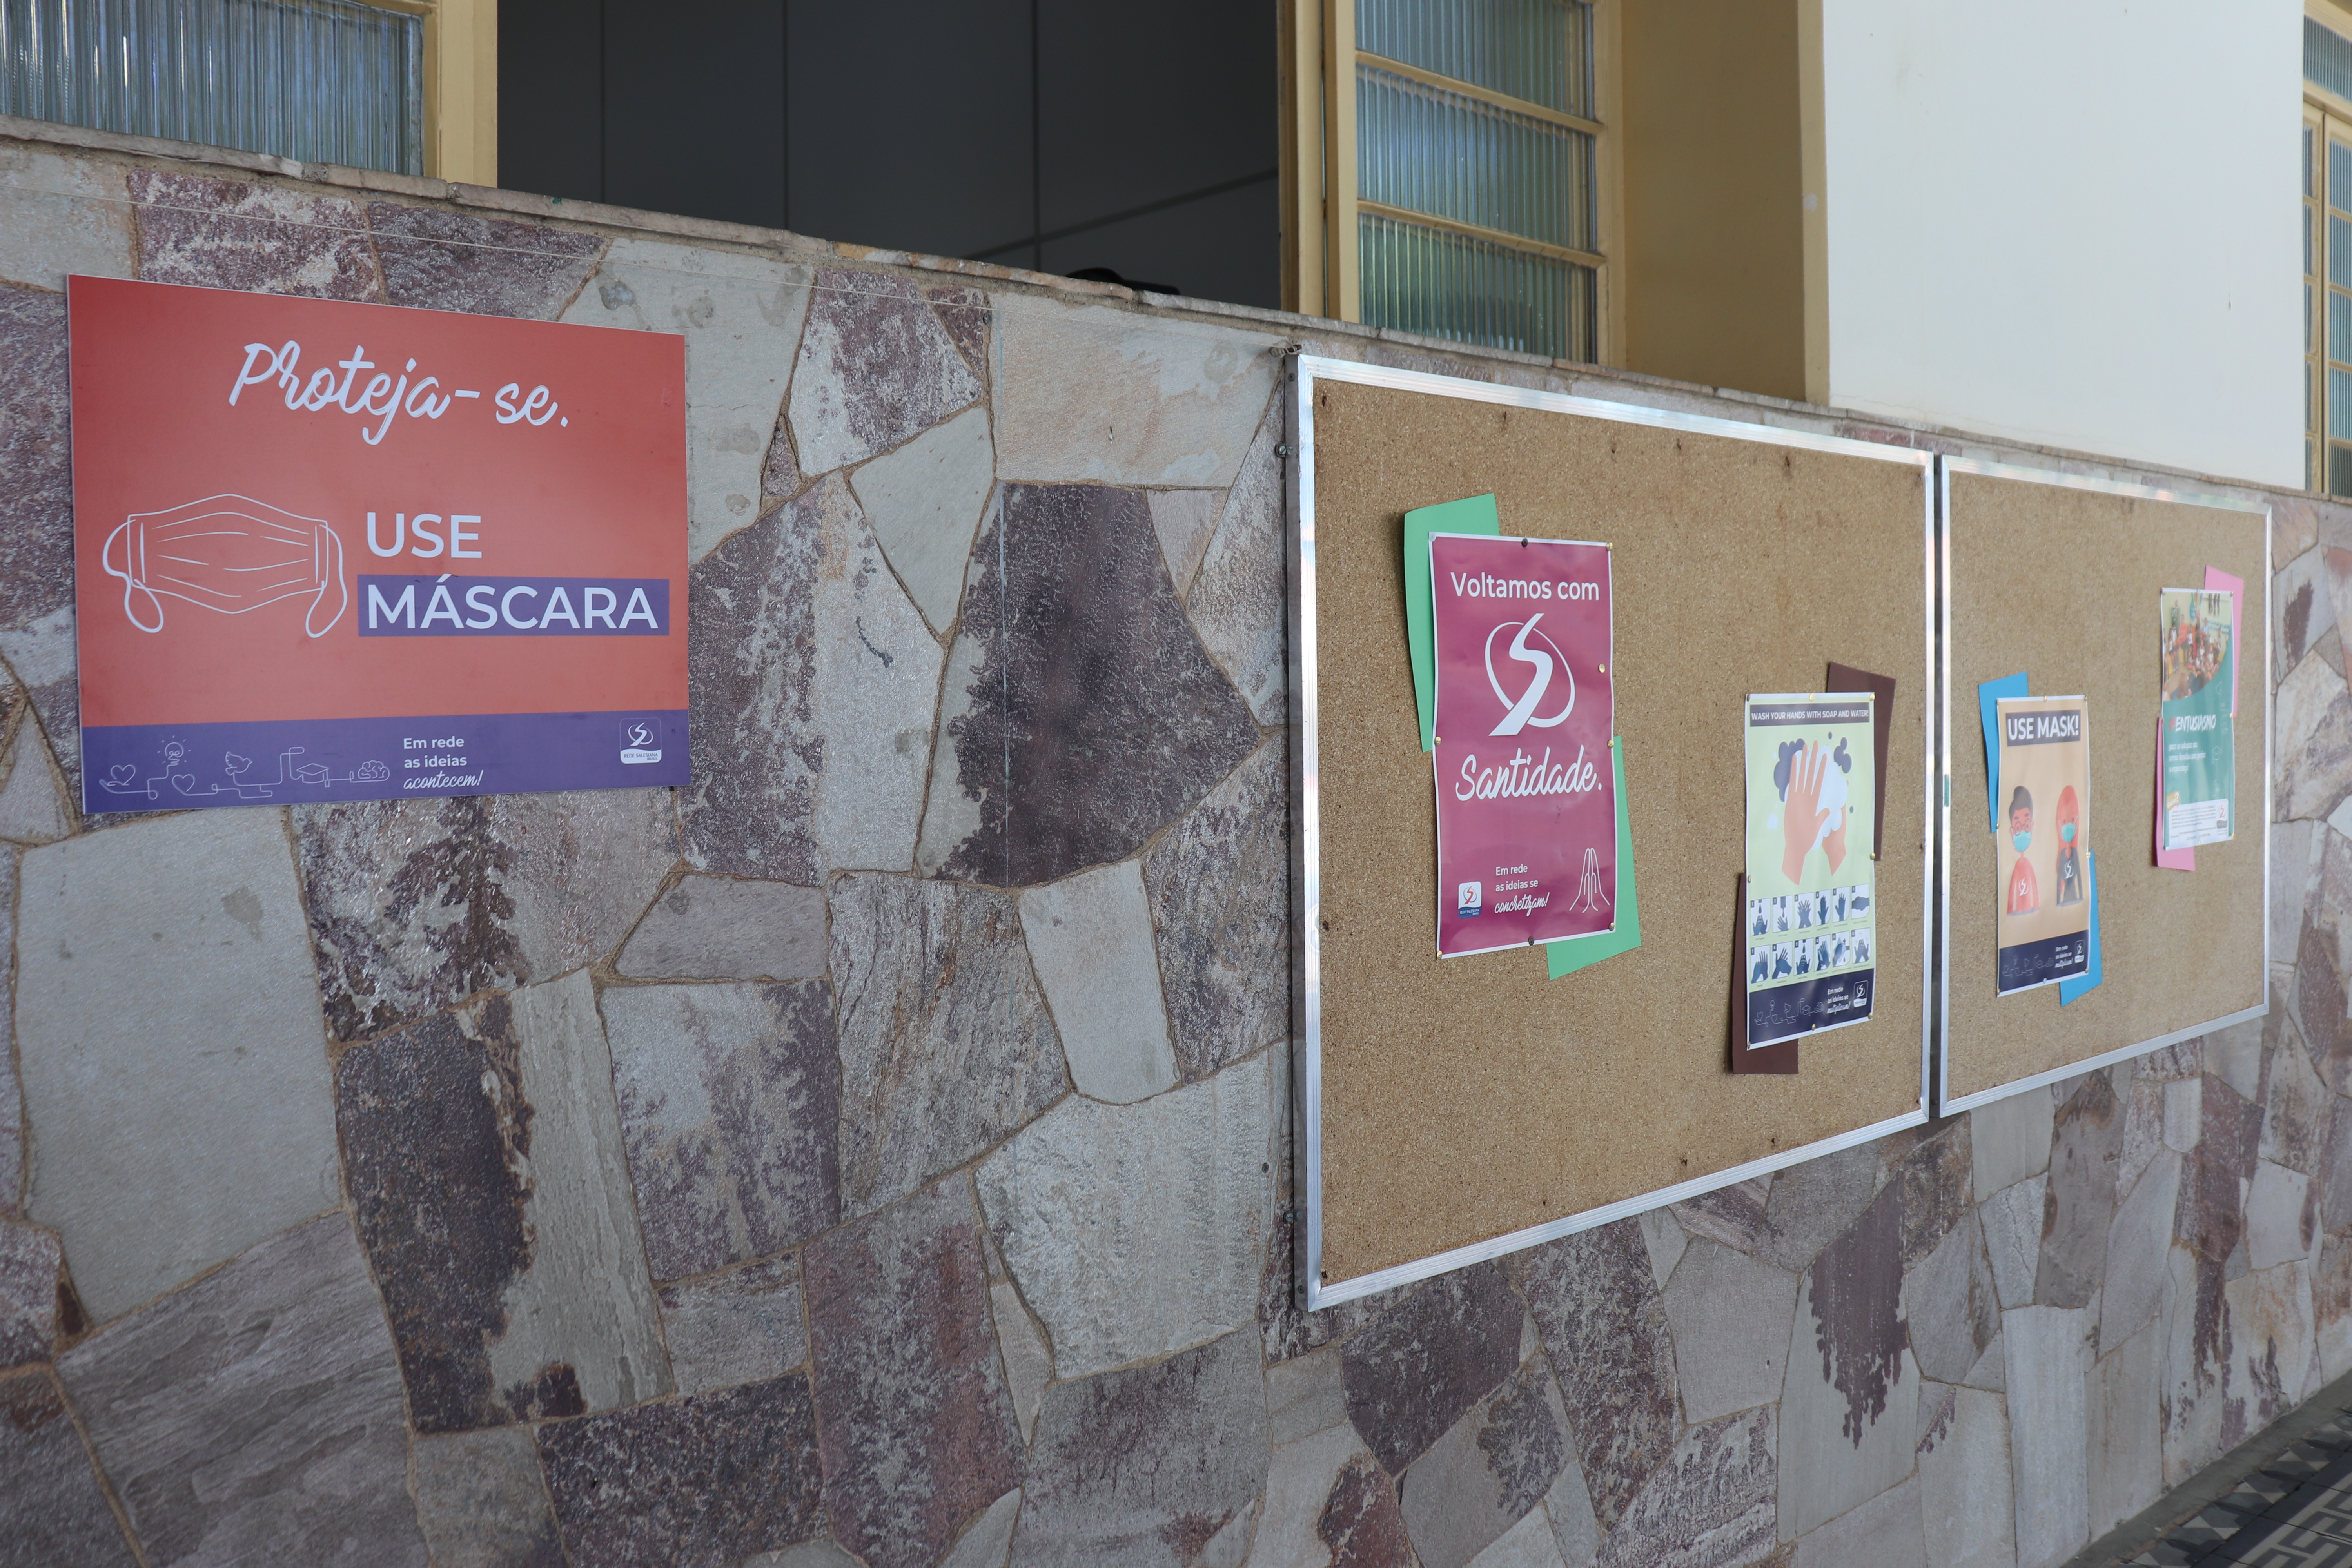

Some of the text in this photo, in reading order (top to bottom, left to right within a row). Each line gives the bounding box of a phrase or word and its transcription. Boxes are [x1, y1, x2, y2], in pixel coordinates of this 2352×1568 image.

[367, 512, 482, 558] USE
[1450, 572, 1599, 601] Voltamos com
[368, 573, 659, 629] MÁSCARA
[2008, 715, 2079, 740] USE MASK!
[2169, 714, 2216, 732] #ENTUSIASMO
[403, 735, 465, 749] Em rede
[404, 754, 467, 768] as ideias
[403, 769, 484, 789] acontecem!
[1455, 744, 1602, 801] Santidade.
[1495, 864, 1528, 876] Em rede
[1506, 880, 1528, 891] ideias
[1494, 892, 1550, 917] concretizam!
